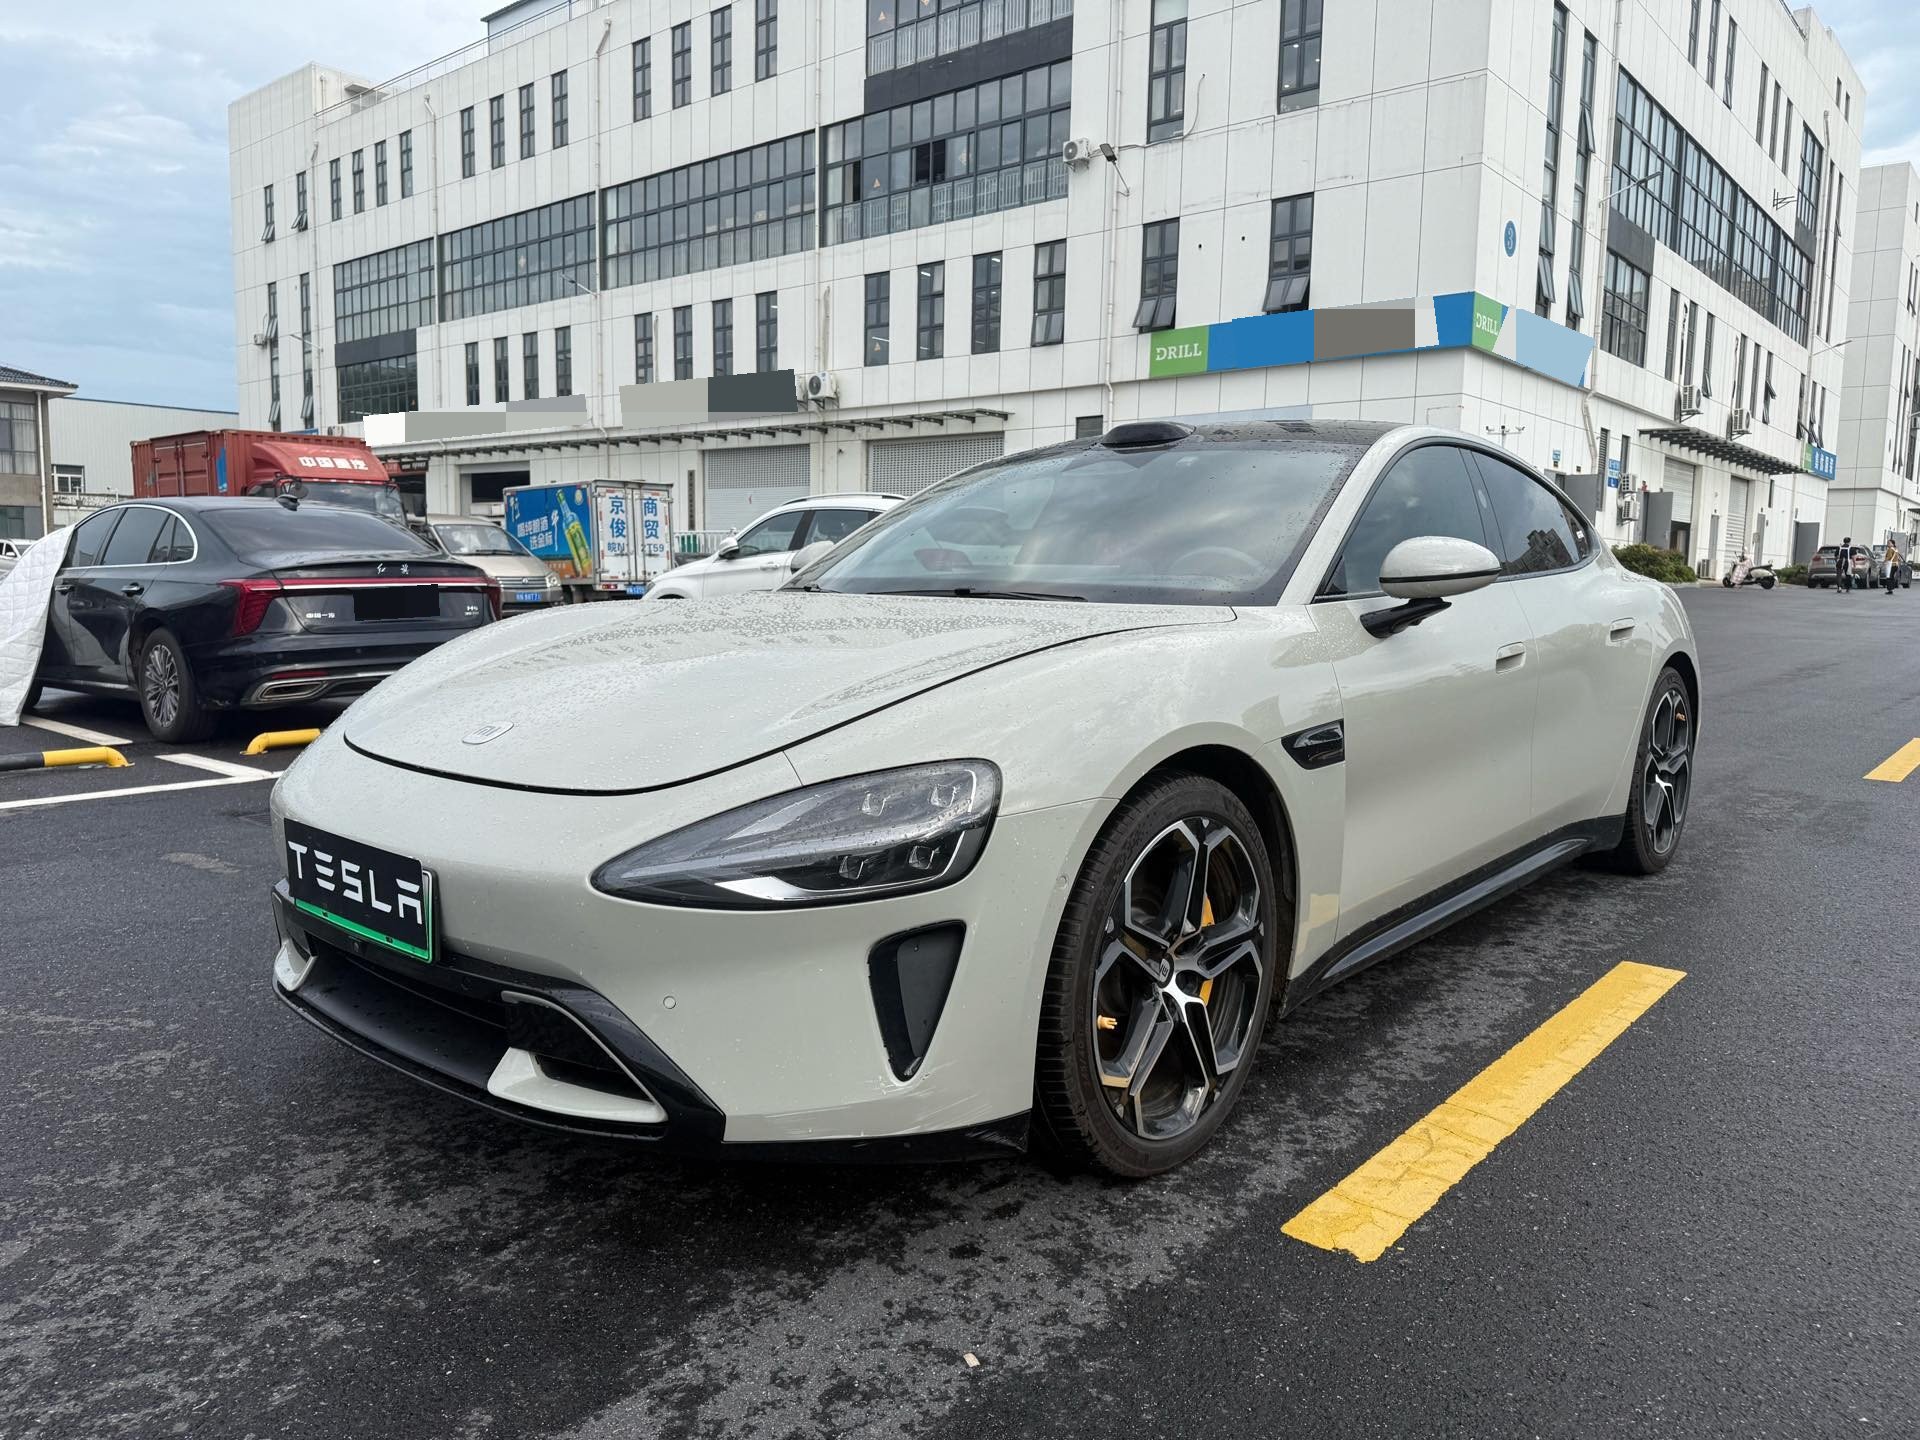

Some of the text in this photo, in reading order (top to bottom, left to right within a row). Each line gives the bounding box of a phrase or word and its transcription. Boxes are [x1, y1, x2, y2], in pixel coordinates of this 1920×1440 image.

[1507, 226, 1514, 250] 3
[1475, 312, 1499, 337] DRILL
[1155, 342, 1202, 361] DRILL
[287, 840, 423, 925] TESLA
